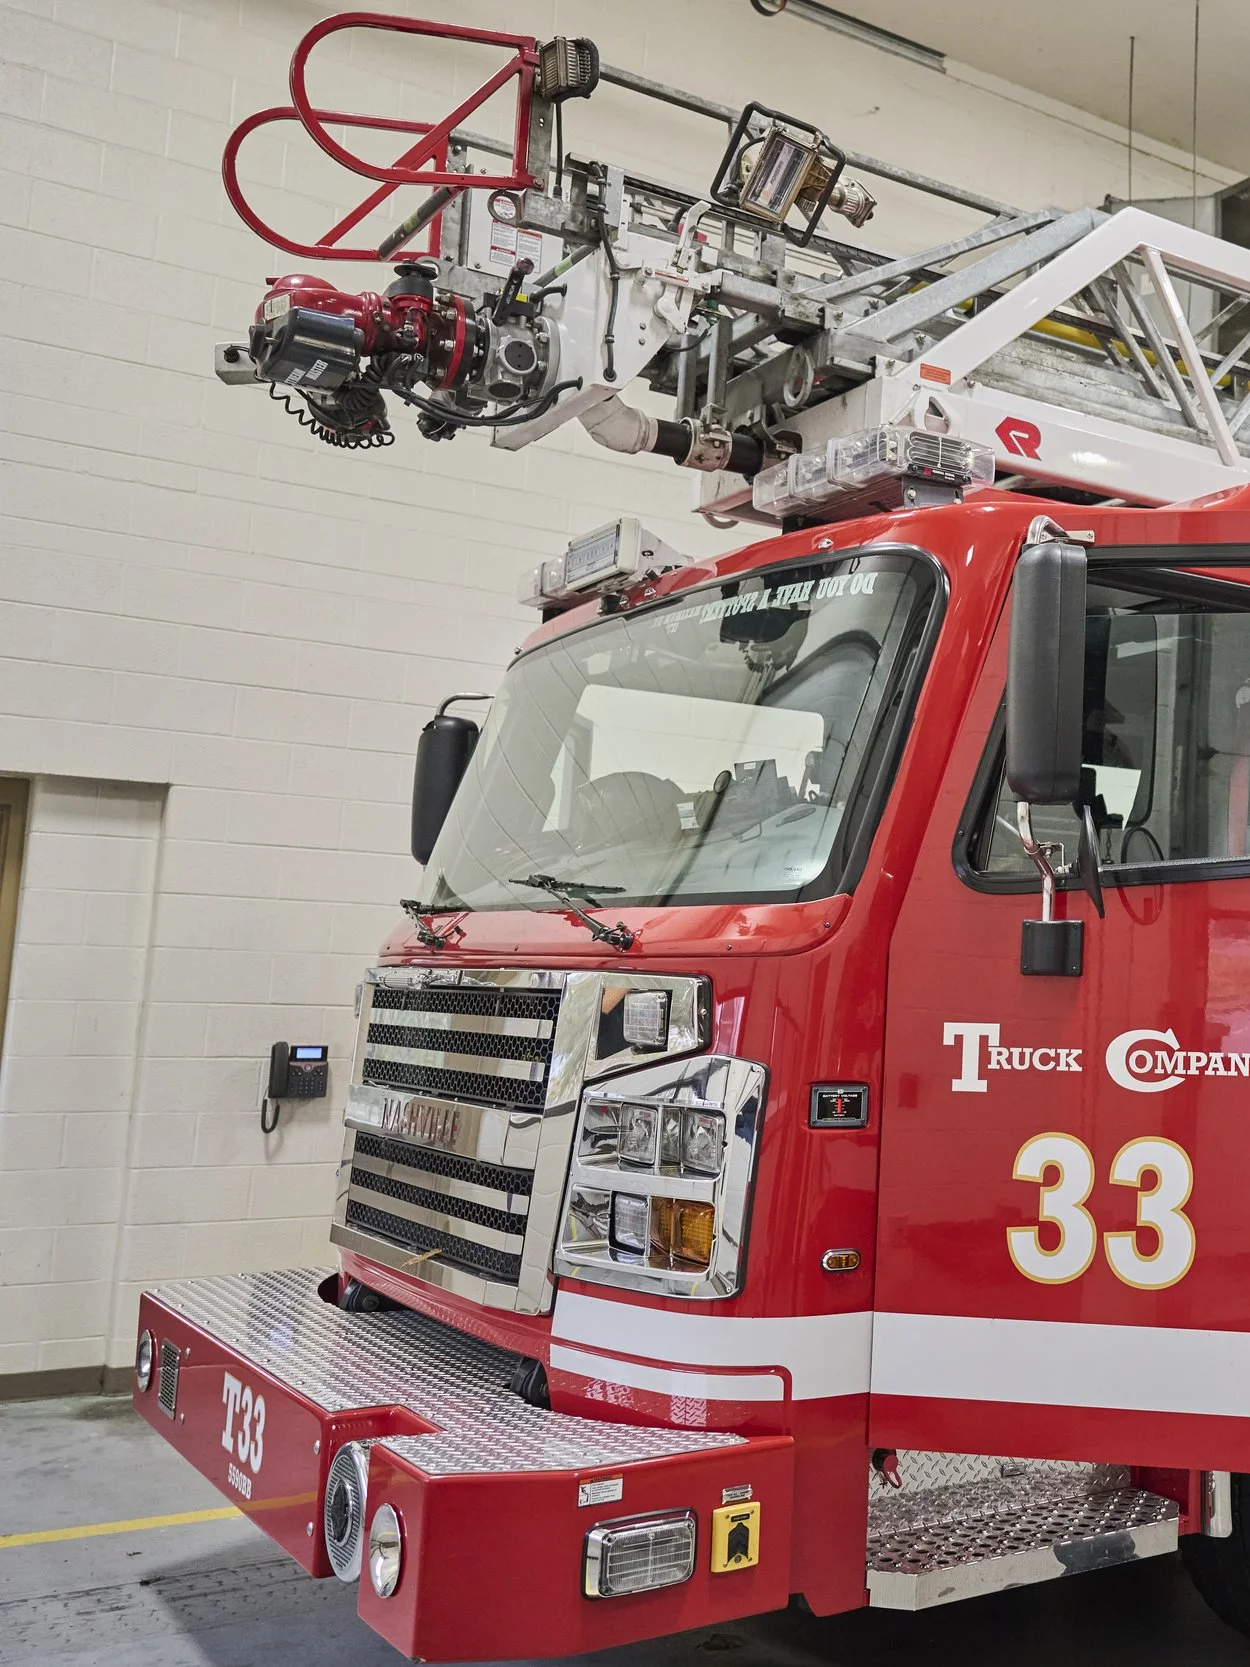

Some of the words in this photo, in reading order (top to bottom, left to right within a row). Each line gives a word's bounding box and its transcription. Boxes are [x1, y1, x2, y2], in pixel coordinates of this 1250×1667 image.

[283, 367, 306, 387] TREAM
[305, 359, 328, 380] MASTER
[943, 1022, 1083, 1093] TRUCK
[381, 1097, 460, 1142] NASHVILLE
[1006, 1131, 1197, 1291] 33
[221, 1370, 266, 1475] T33
